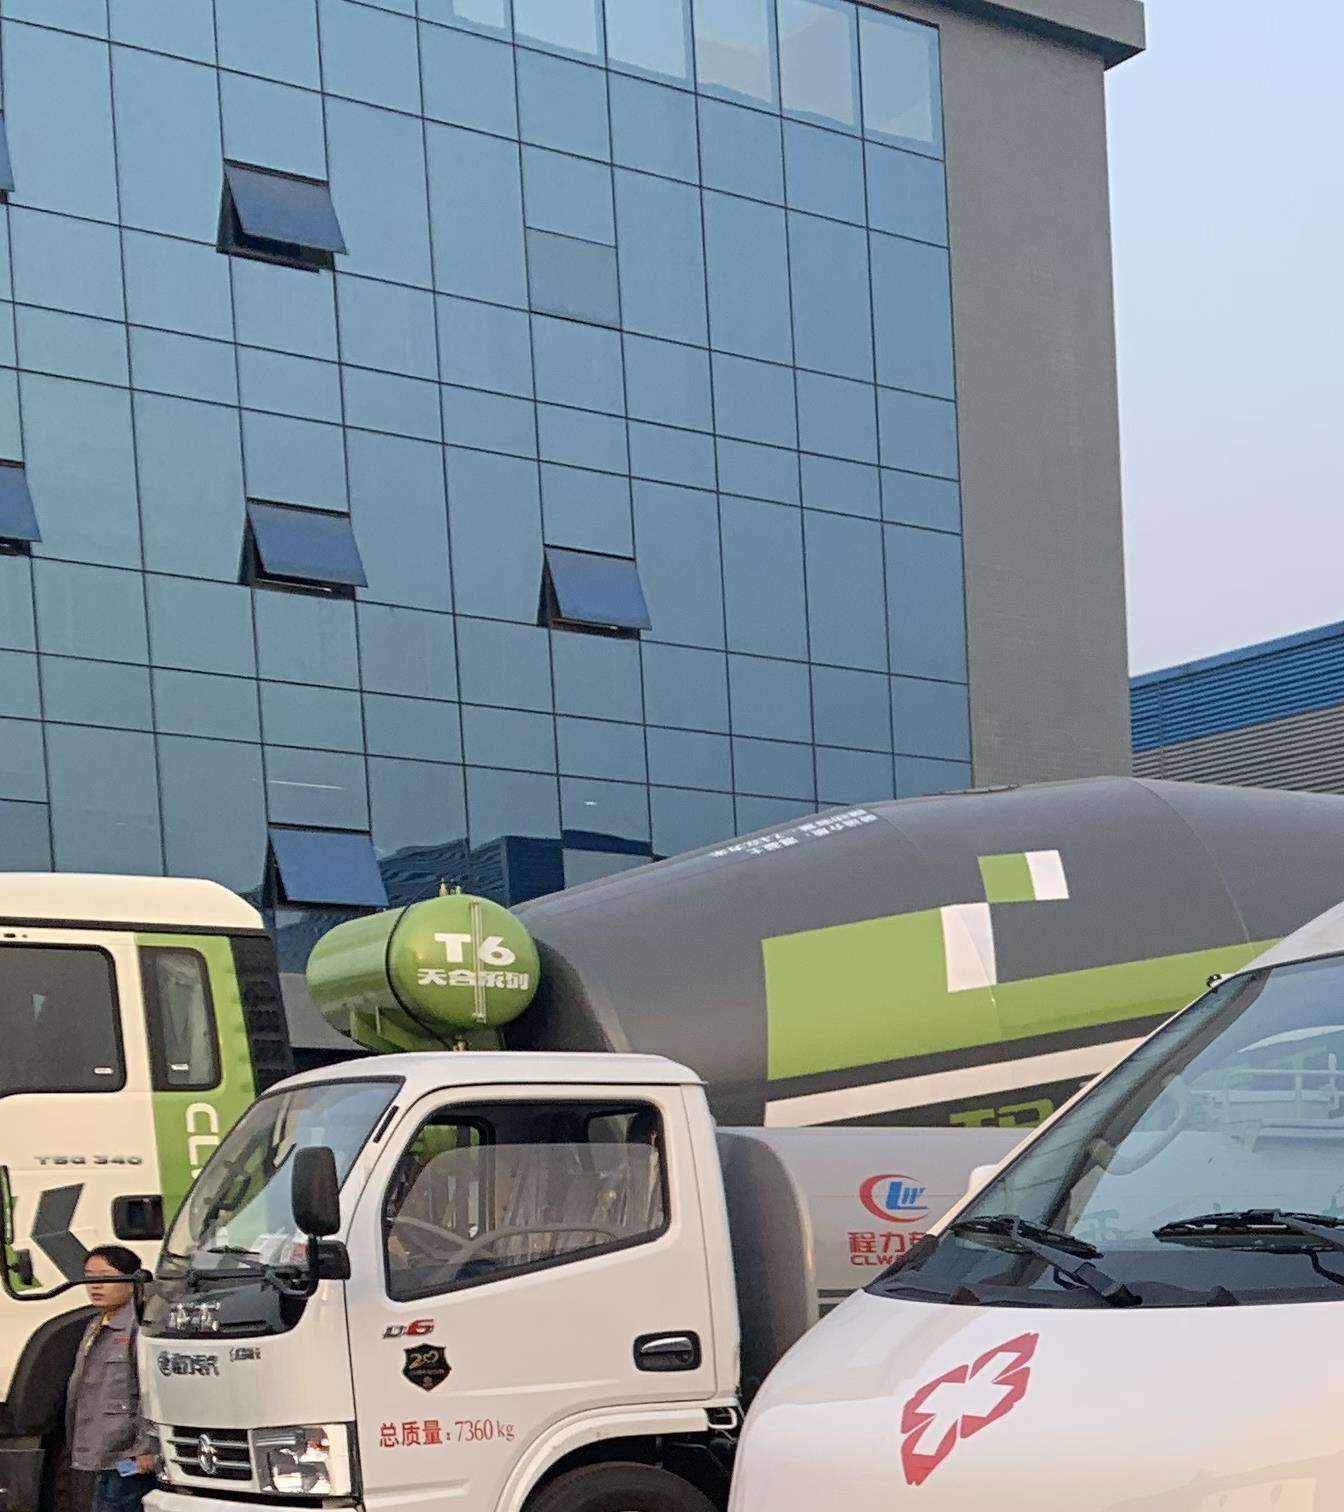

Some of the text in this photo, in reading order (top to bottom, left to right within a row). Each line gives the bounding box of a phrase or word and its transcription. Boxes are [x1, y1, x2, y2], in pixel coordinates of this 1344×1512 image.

[434, 933, 516, 966] T6
[185, 1102, 219, 1180] CL
[93, 1154, 142, 1165] 340
